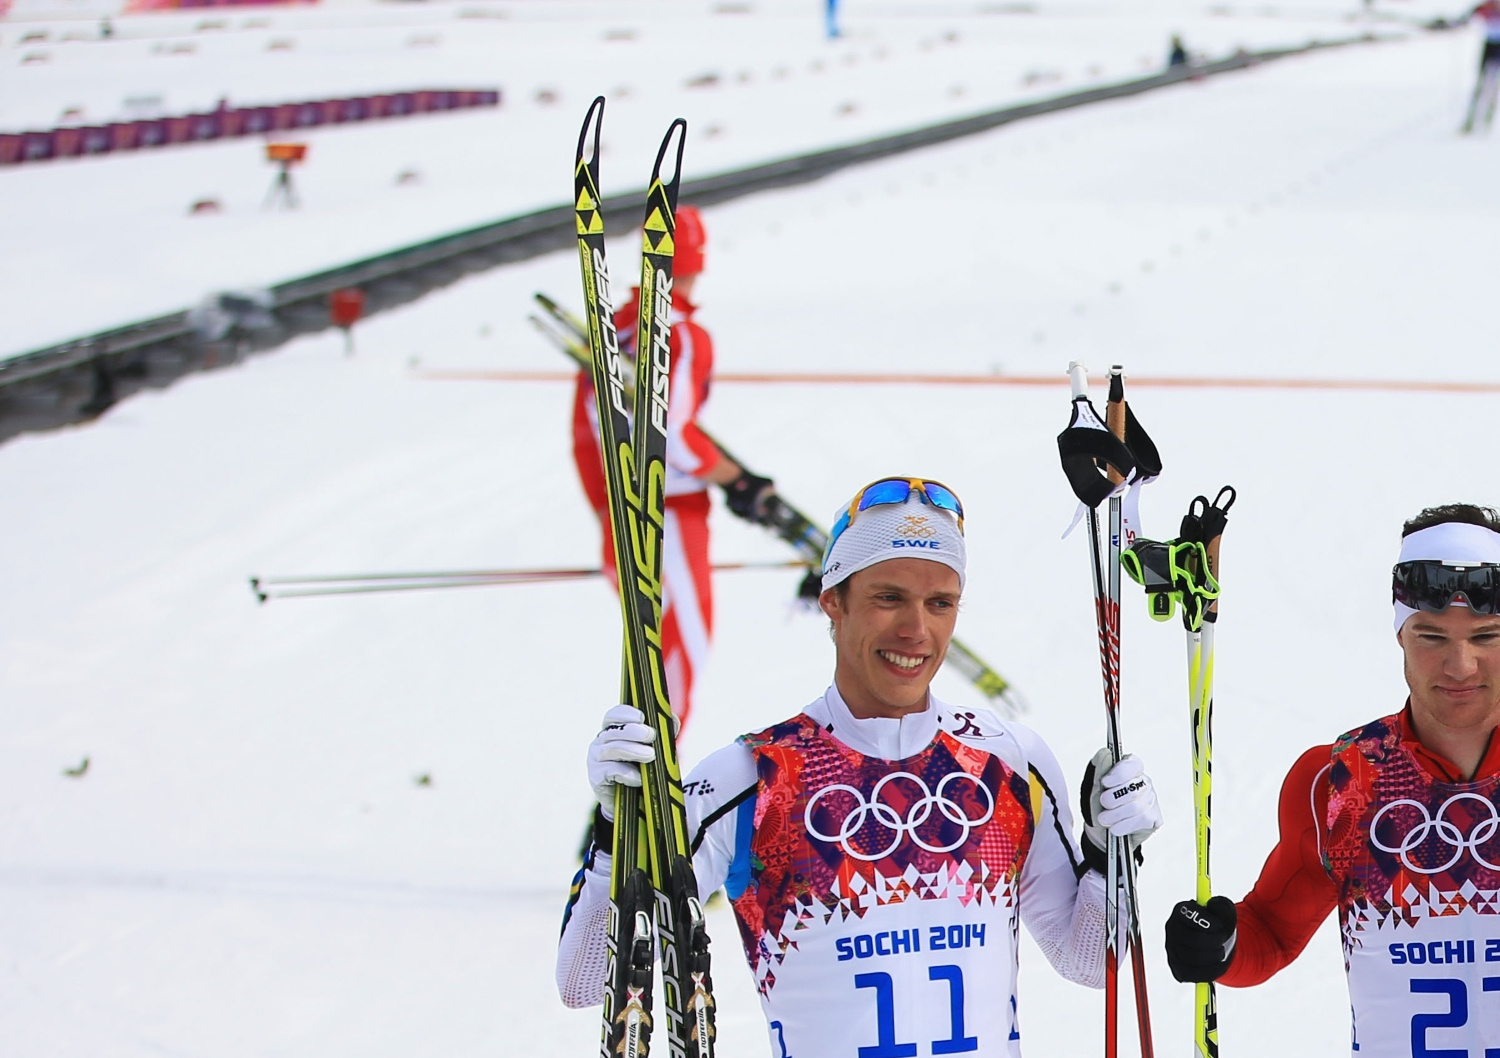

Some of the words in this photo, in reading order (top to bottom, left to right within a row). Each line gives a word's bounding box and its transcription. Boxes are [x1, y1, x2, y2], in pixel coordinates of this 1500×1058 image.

[595, 247, 629, 418] FISCHER
[650, 268, 673, 438] FISCHER
[892, 539, 941, 549] SWE
[836, 928, 921, 961] SOCHI
[929, 923, 986, 952] 2014
[1388, 942, 1477, 965] SOCHI
